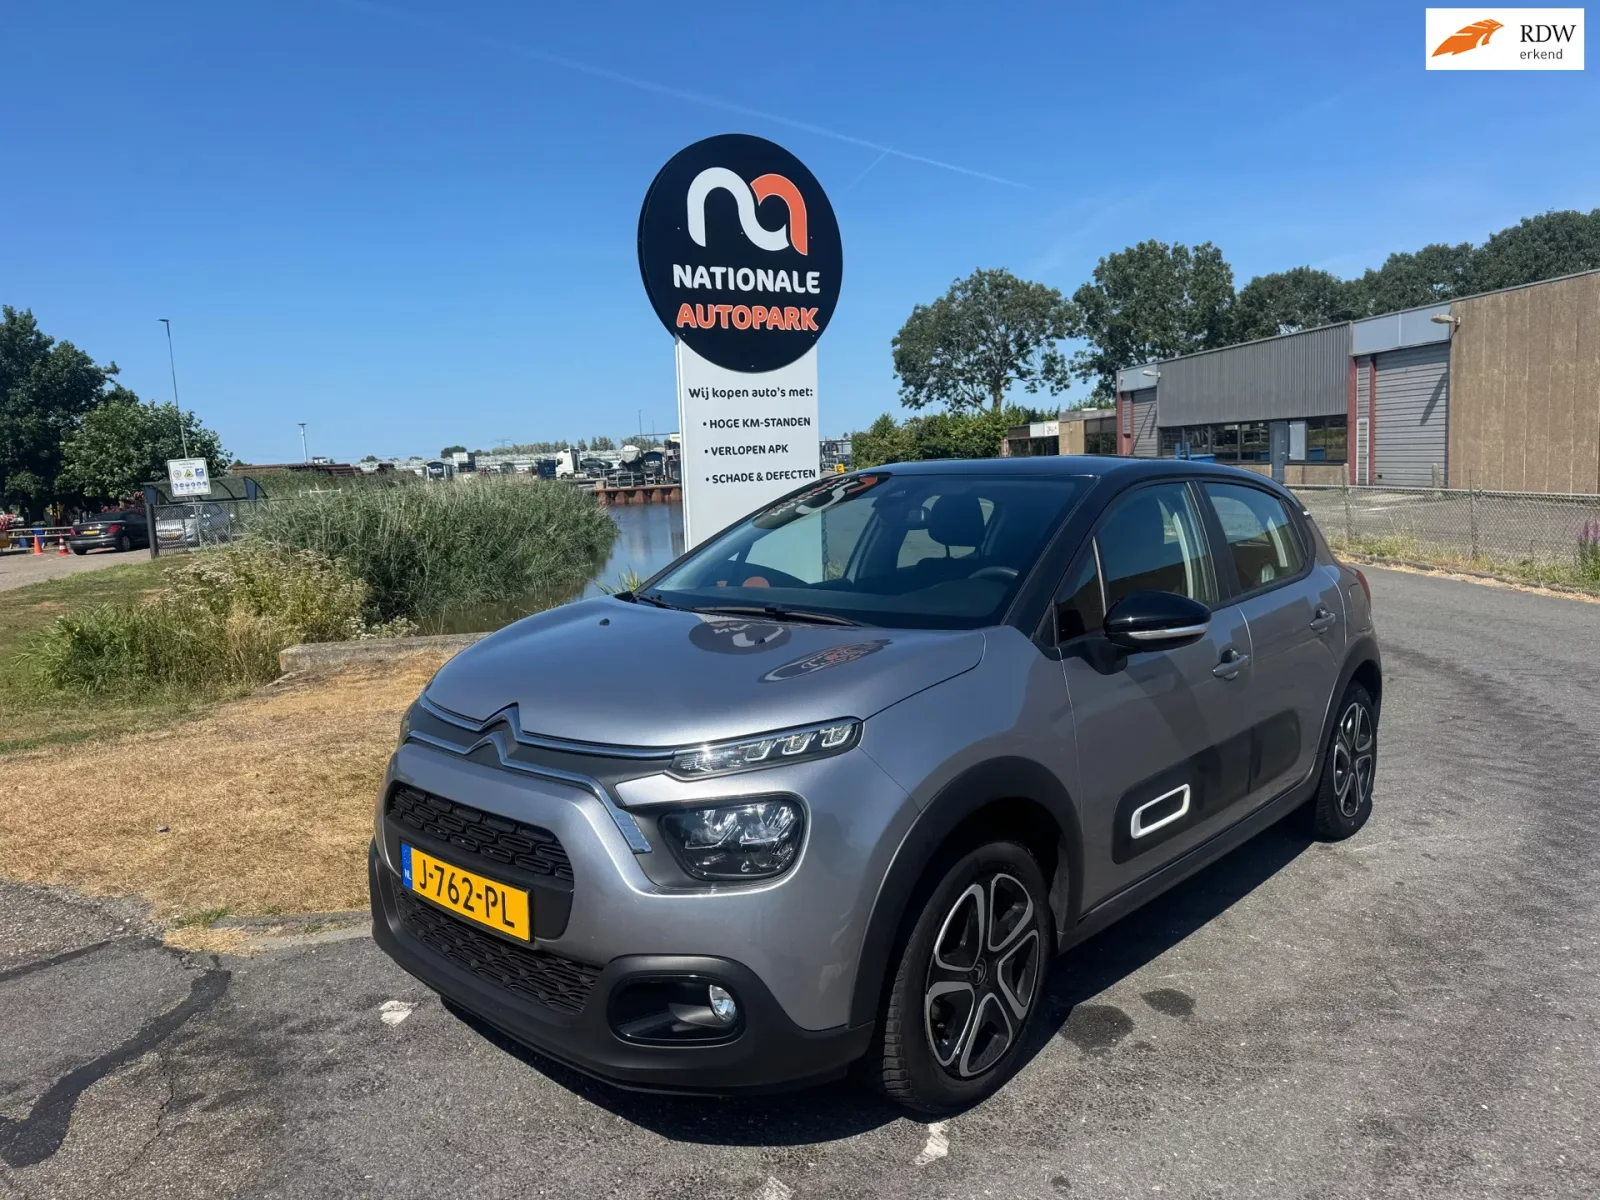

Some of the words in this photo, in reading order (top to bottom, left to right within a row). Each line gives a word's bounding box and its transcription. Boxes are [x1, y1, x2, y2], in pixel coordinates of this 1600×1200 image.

[672, 263, 821, 294] NATIONALE
[675, 302, 820, 332] AUTOPARK
[688, 387, 710, 401] Wij
[711, 387, 748, 400] kopen
[751, 387, 787, 399] auto's
[788, 387, 814, 398] met:
[709, 418, 740, 428] HOGE
[742, 417, 811, 428] KM-STANDEN
[711, 446, 766, 456] VERLOPEN
[767, 443, 789, 455] APK
[711, 472, 755, 484] SCHADE
[756, 471, 764, 482] &
[765, 469, 816, 480] DEFECTEN
[419, 858, 516, 929] J-762-PL
